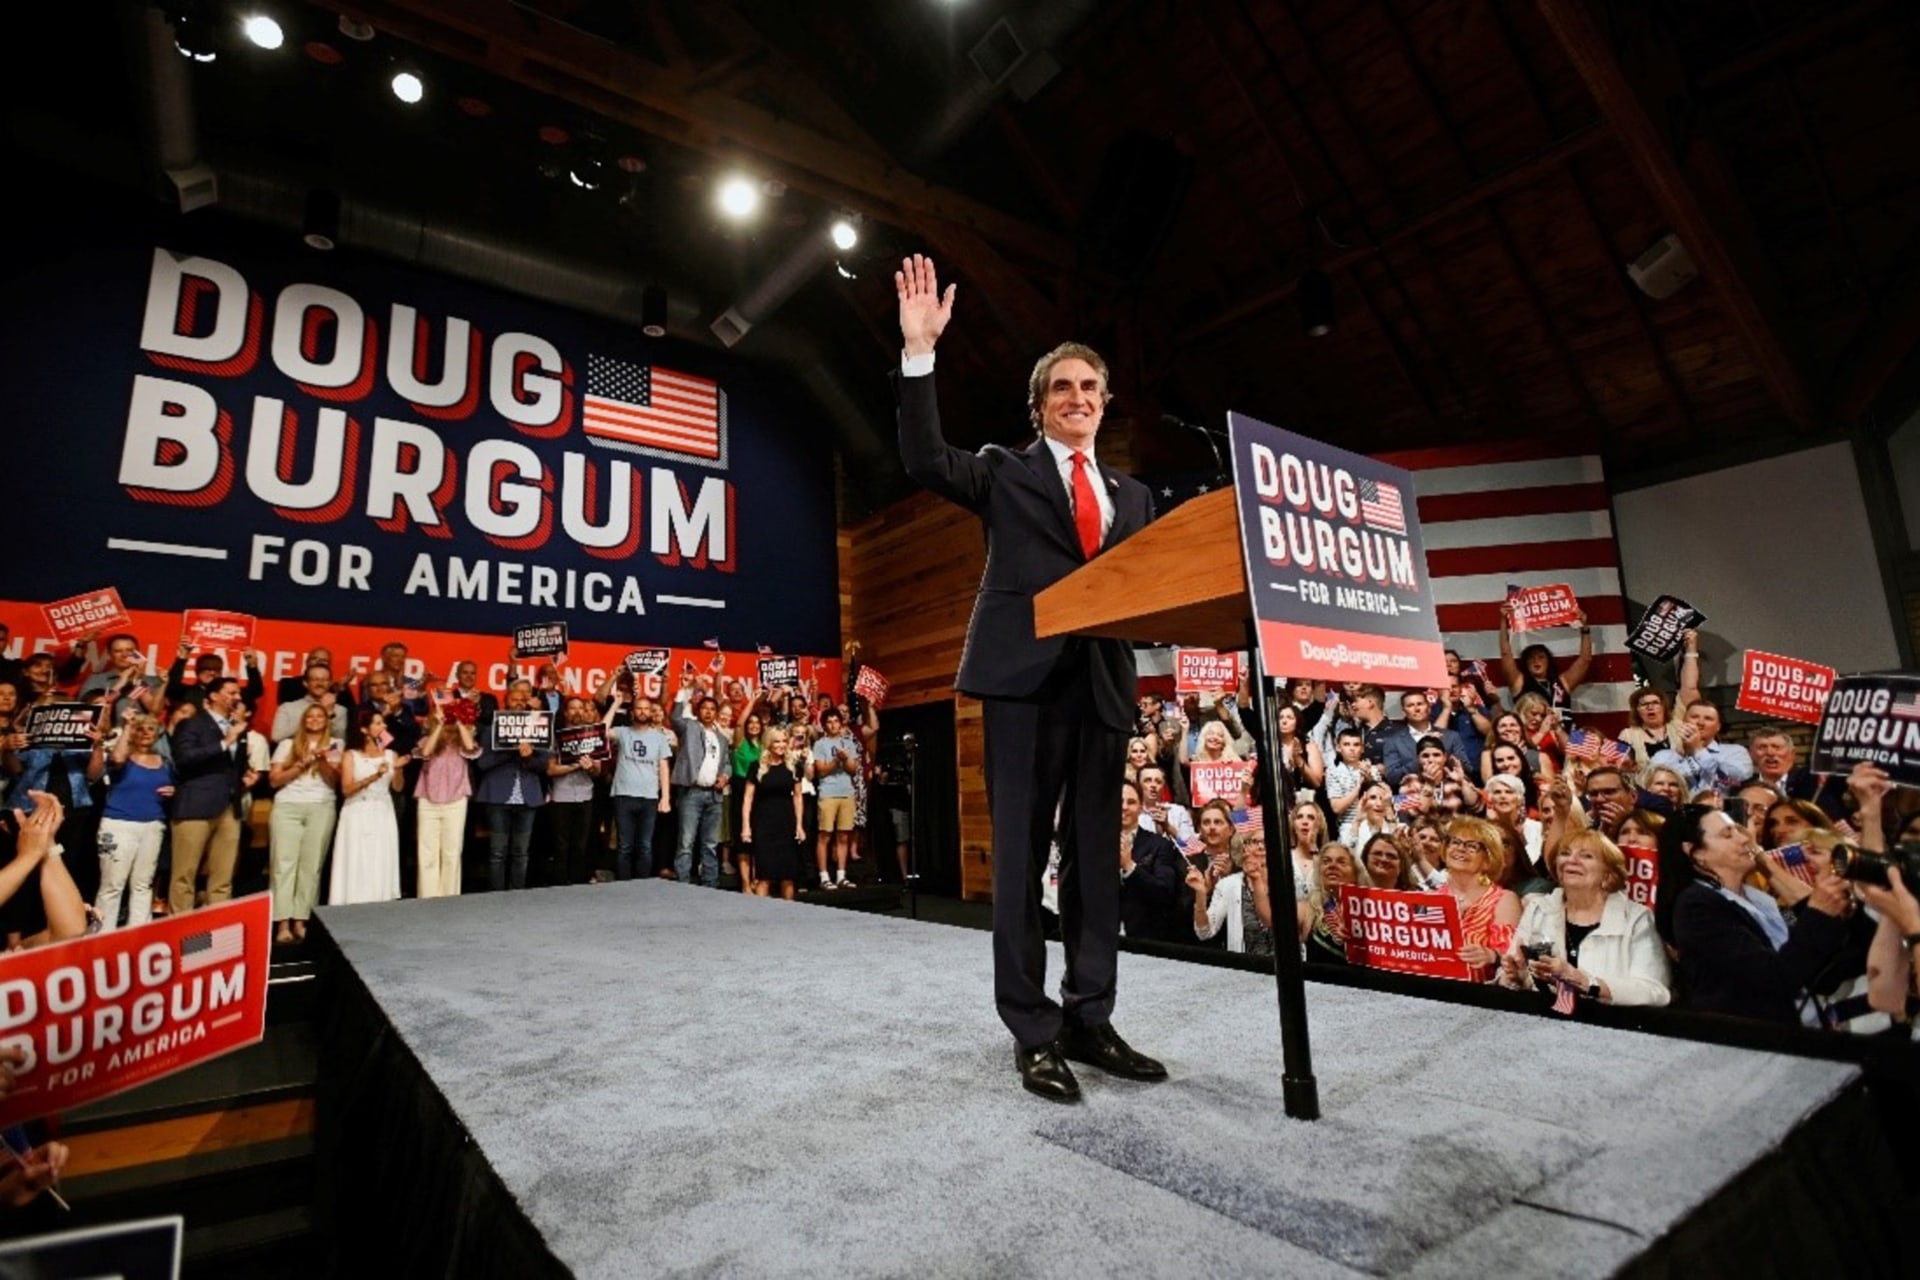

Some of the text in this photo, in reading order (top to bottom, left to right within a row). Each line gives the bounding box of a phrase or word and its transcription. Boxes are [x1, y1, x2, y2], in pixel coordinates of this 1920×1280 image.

[140, 247, 571, 434] DOUG
[118, 374, 733, 568] BURGUM
[1251, 442, 1358, 520] DOUG
[1259, 505, 1416, 589] BURGUM
[248, 533, 647, 616] FOR AMERICA
[49, 599, 93, 619] DOUG
[1299, 578, 1400, 617] FOR AMERICA
[54, 603, 119, 630] BURGUM
[1299, 638, 1418, 671] DougBurgum.com
[1751, 659, 1803, 682] DOUG
[1749, 676, 1829, 705] BURGUM
[1828, 688, 1891, 716] DOUG
[1831, 747, 1900, 766] FOR AMERICA
[1348, 895, 1411, 923] DOUG
[1351, 917, 1453, 950] BURGUM
[1368, 944, 1436, 962] FOR AMERICA
[0, 942, 173, 1031] DOUG
[47, 1062, 96, 1091] FOR
[106, 1021, 207, 1071] AMERICA
